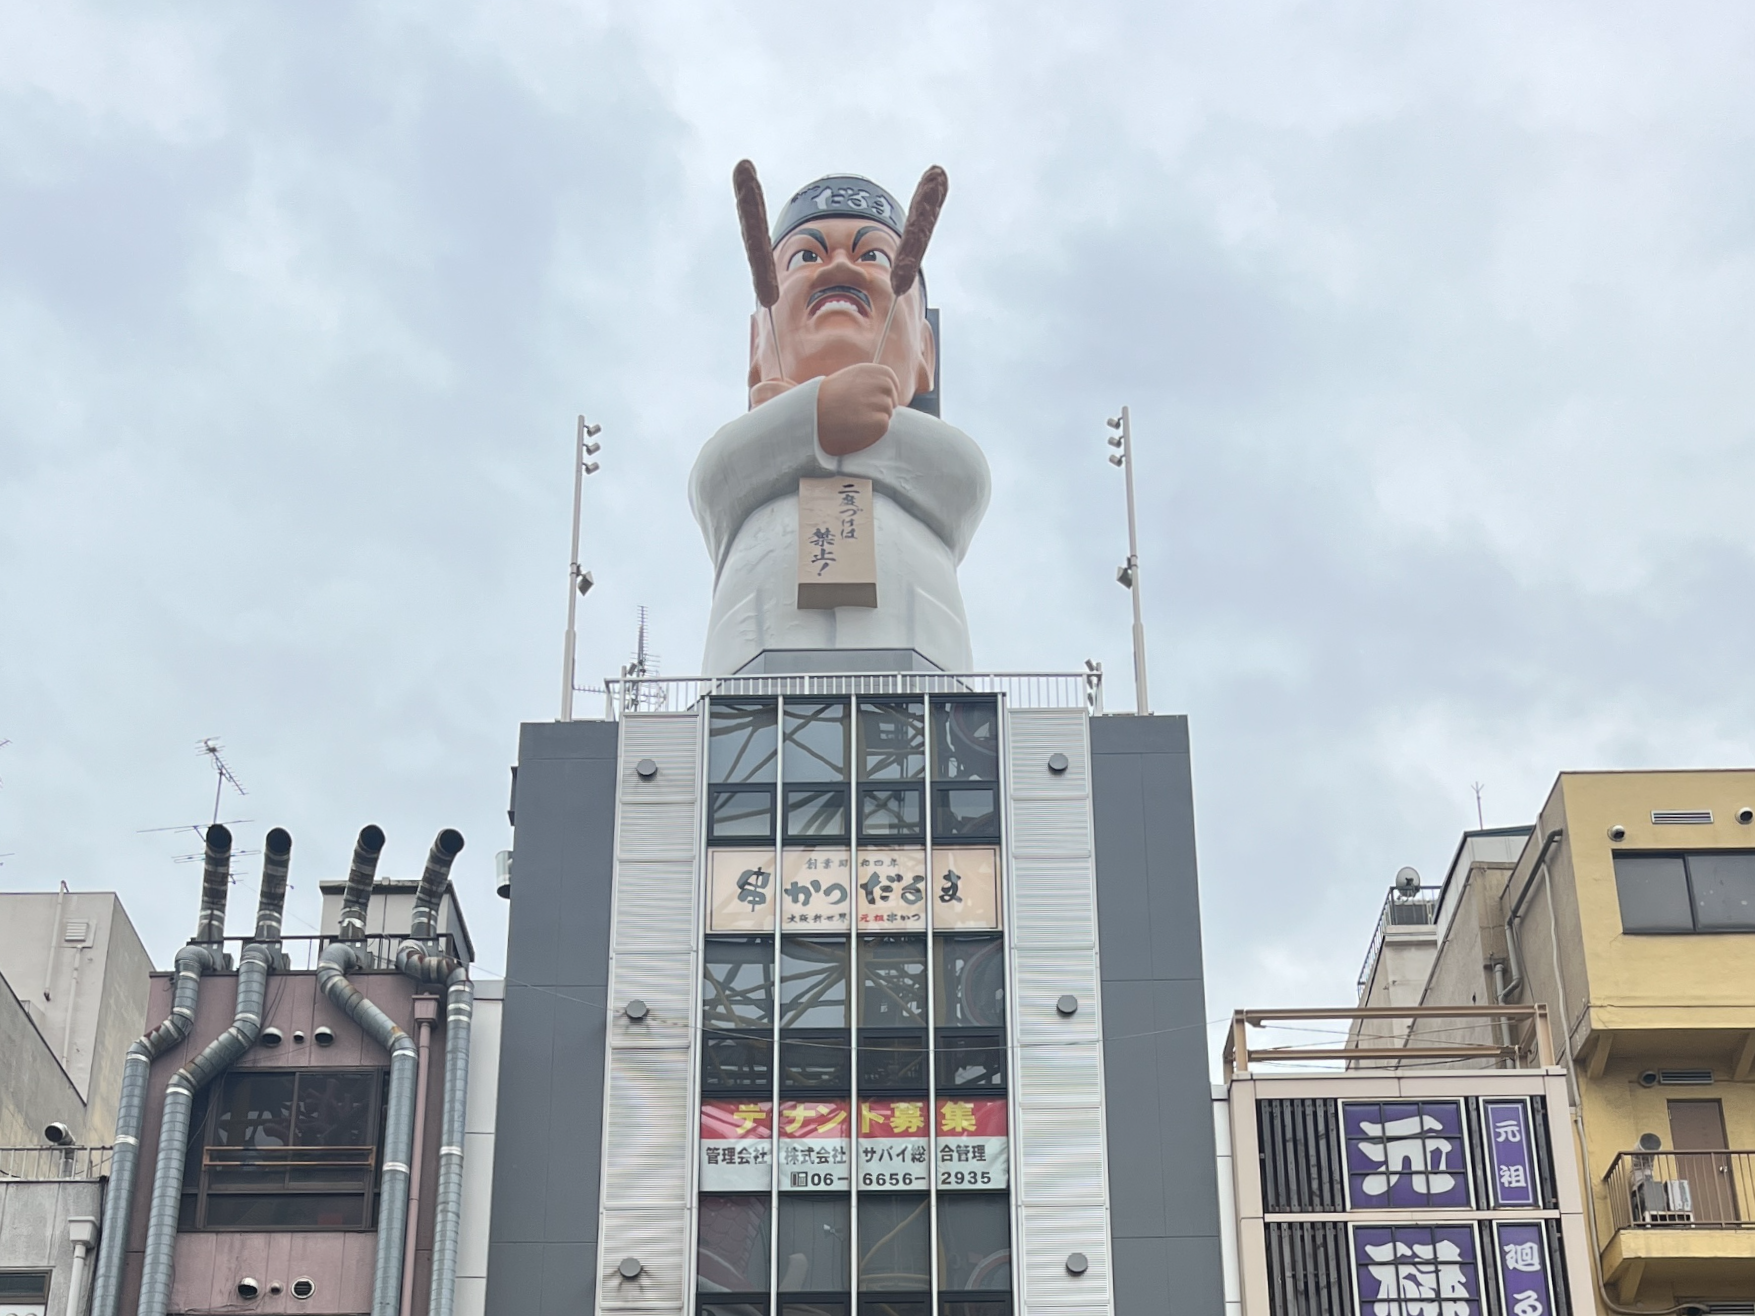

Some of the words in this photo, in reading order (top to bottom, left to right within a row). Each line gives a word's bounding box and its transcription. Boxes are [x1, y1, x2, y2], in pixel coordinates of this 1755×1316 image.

[838, 484, 863, 540] 二度づけは
[733, 1101, 978, 1134] テナント募集
